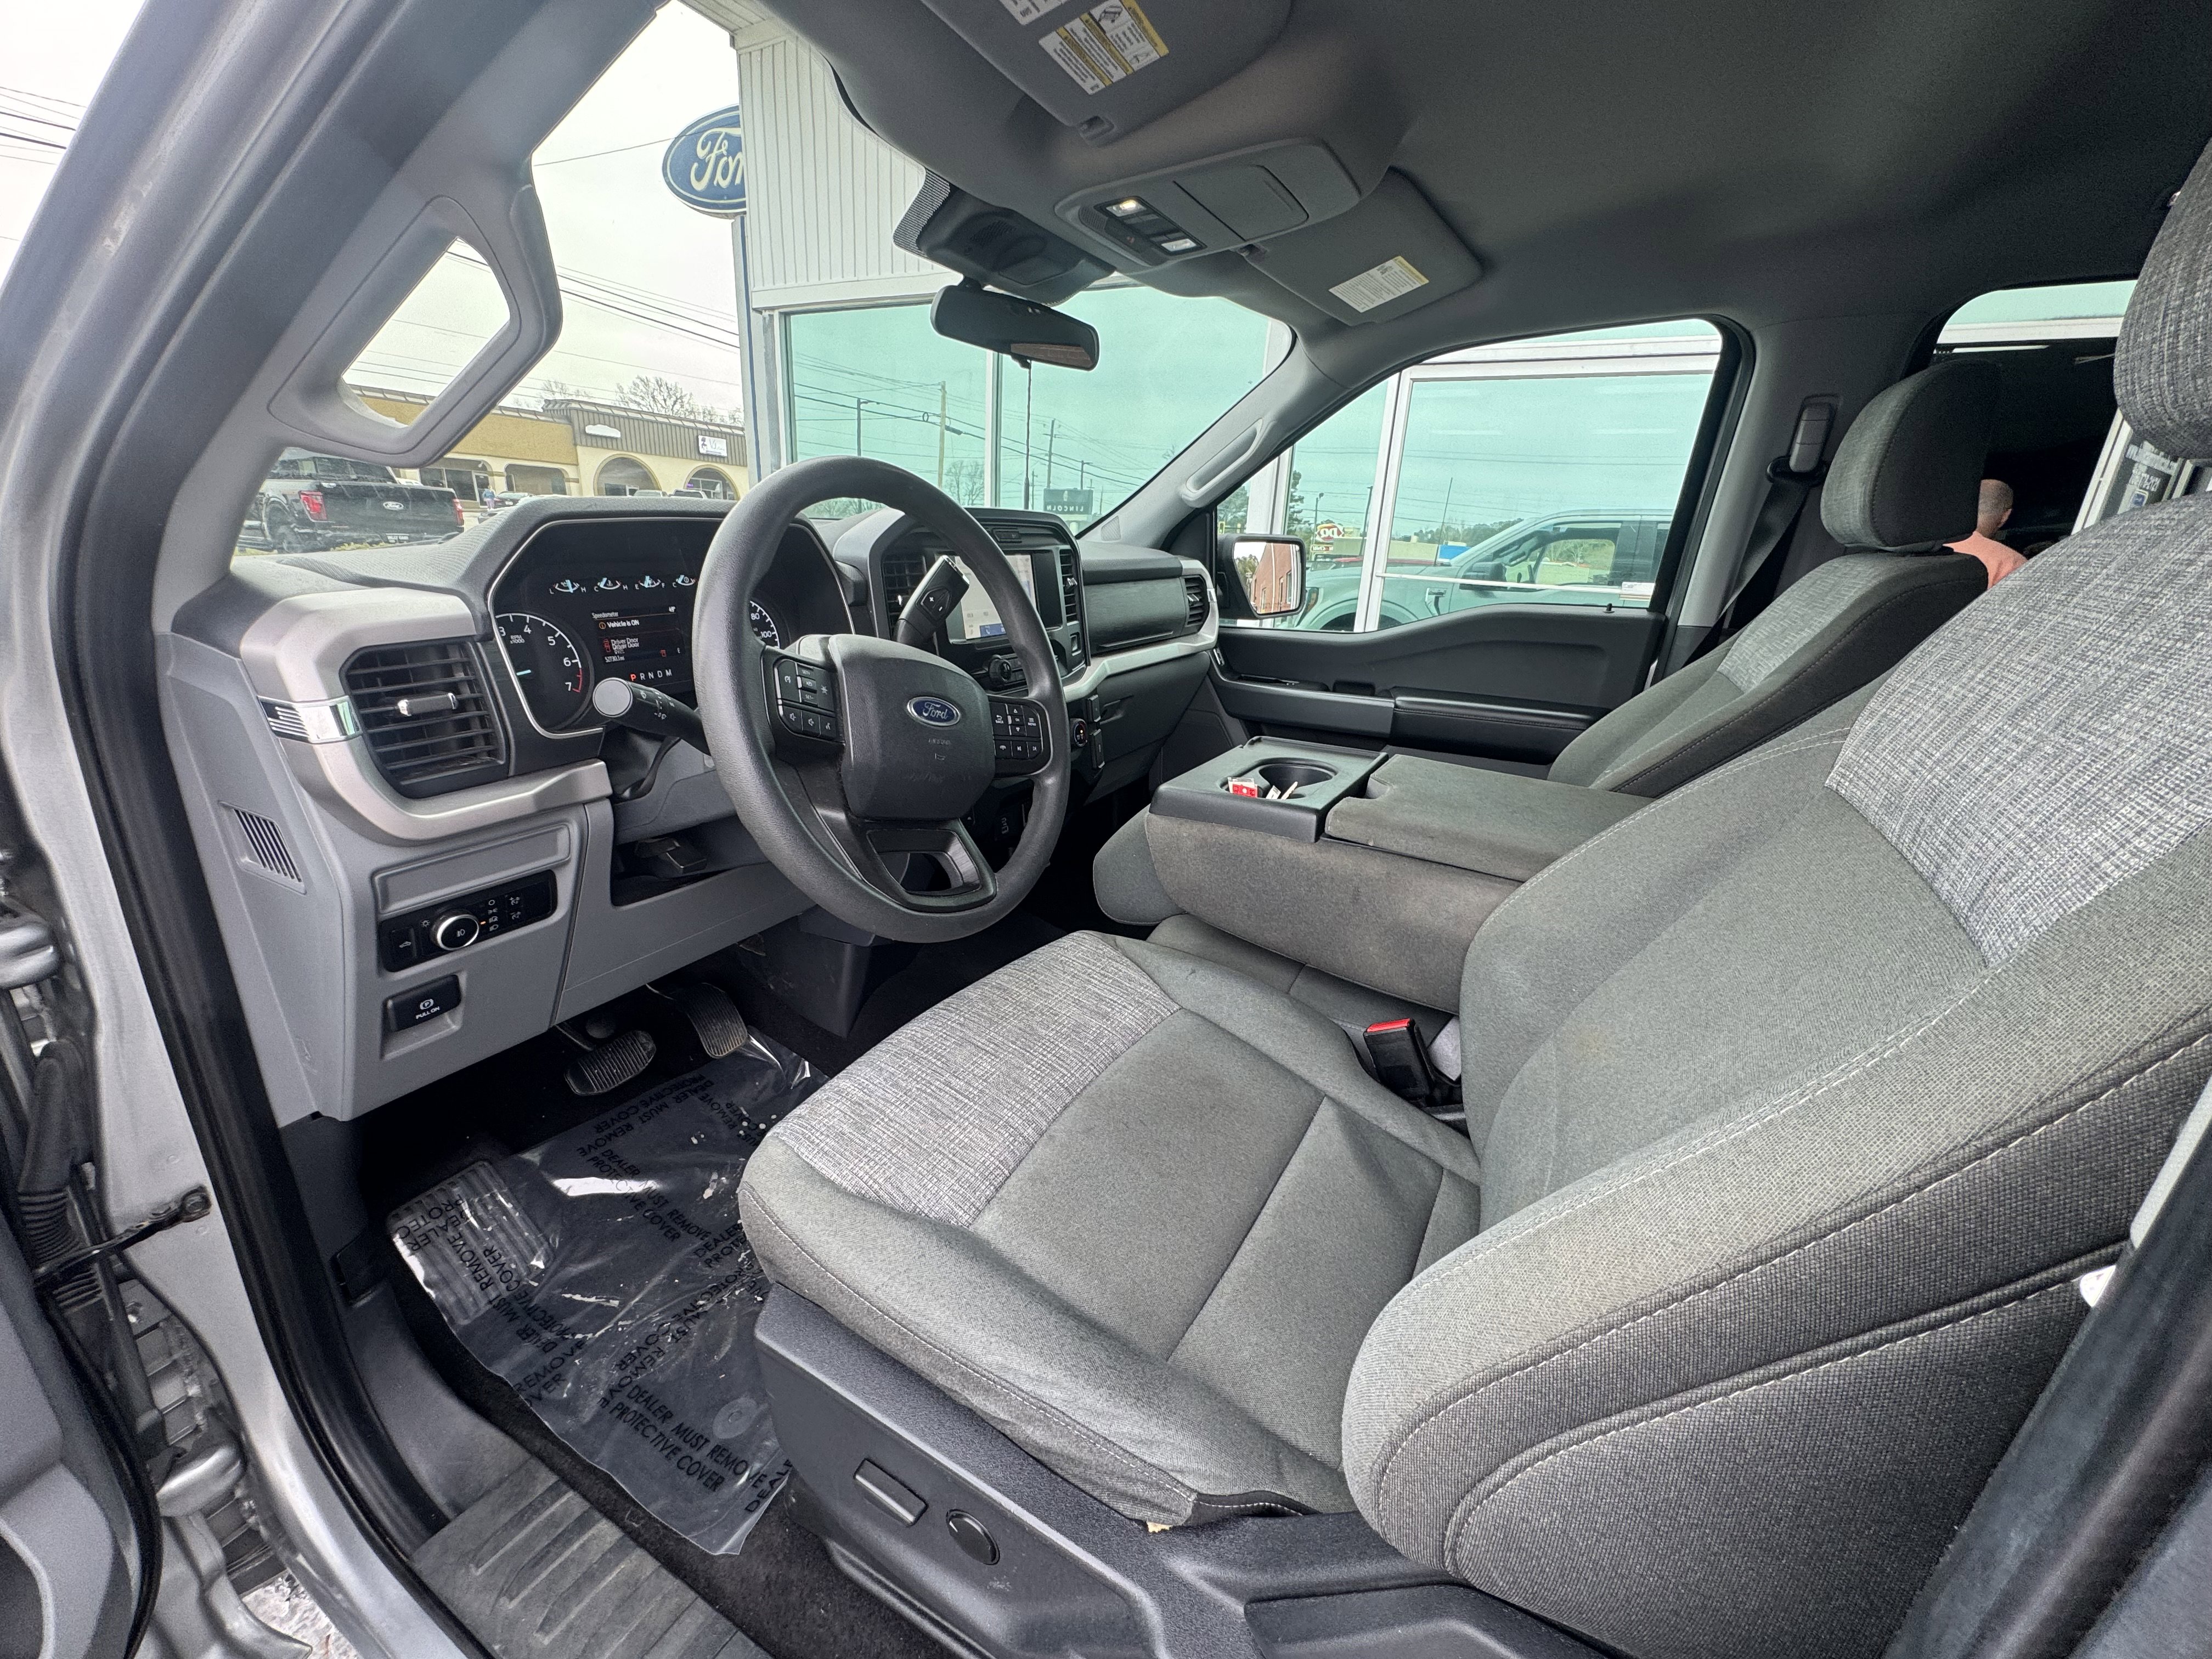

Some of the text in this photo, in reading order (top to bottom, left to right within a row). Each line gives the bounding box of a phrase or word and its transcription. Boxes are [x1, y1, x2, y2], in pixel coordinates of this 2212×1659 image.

[523, 624, 532, 634] 4
[592, 612, 619, 620] Speedometer
[751, 612, 760, 620] 80
[498, 627, 506, 636] 3
[548, 636, 556, 646] 5
[563, 657, 571, 667] 6
[665, 669, 672, 677] M
[565, 682, 572, 691] 7
[923, 702, 948, 720] Ford
[415, 1011, 431, 1019] PULL
[577, 1079, 713, 1156] DEALER MUST REMOVE
[593, 1105, 639, 1133] COVER
[697, 1094, 737, 1130] REMOVE
[587, 1155, 682, 1243] PROTECTIVE COVER
[601, 1148, 641, 1177] DEALER
[667, 1209, 712, 1241] REMOVE
[448, 1234, 494, 1291] REMOVE
[483, 1245, 521, 1292] COVER
[489, 1294, 521, 1323] MUST
[615, 1322, 672, 1371] COVER
[597, 1347, 665, 1409] REMOVE
[609, 1402, 725, 1492] PROTECTIVE COVER
[627, 1385, 767, 1488] DEALER MUST REMOVE
